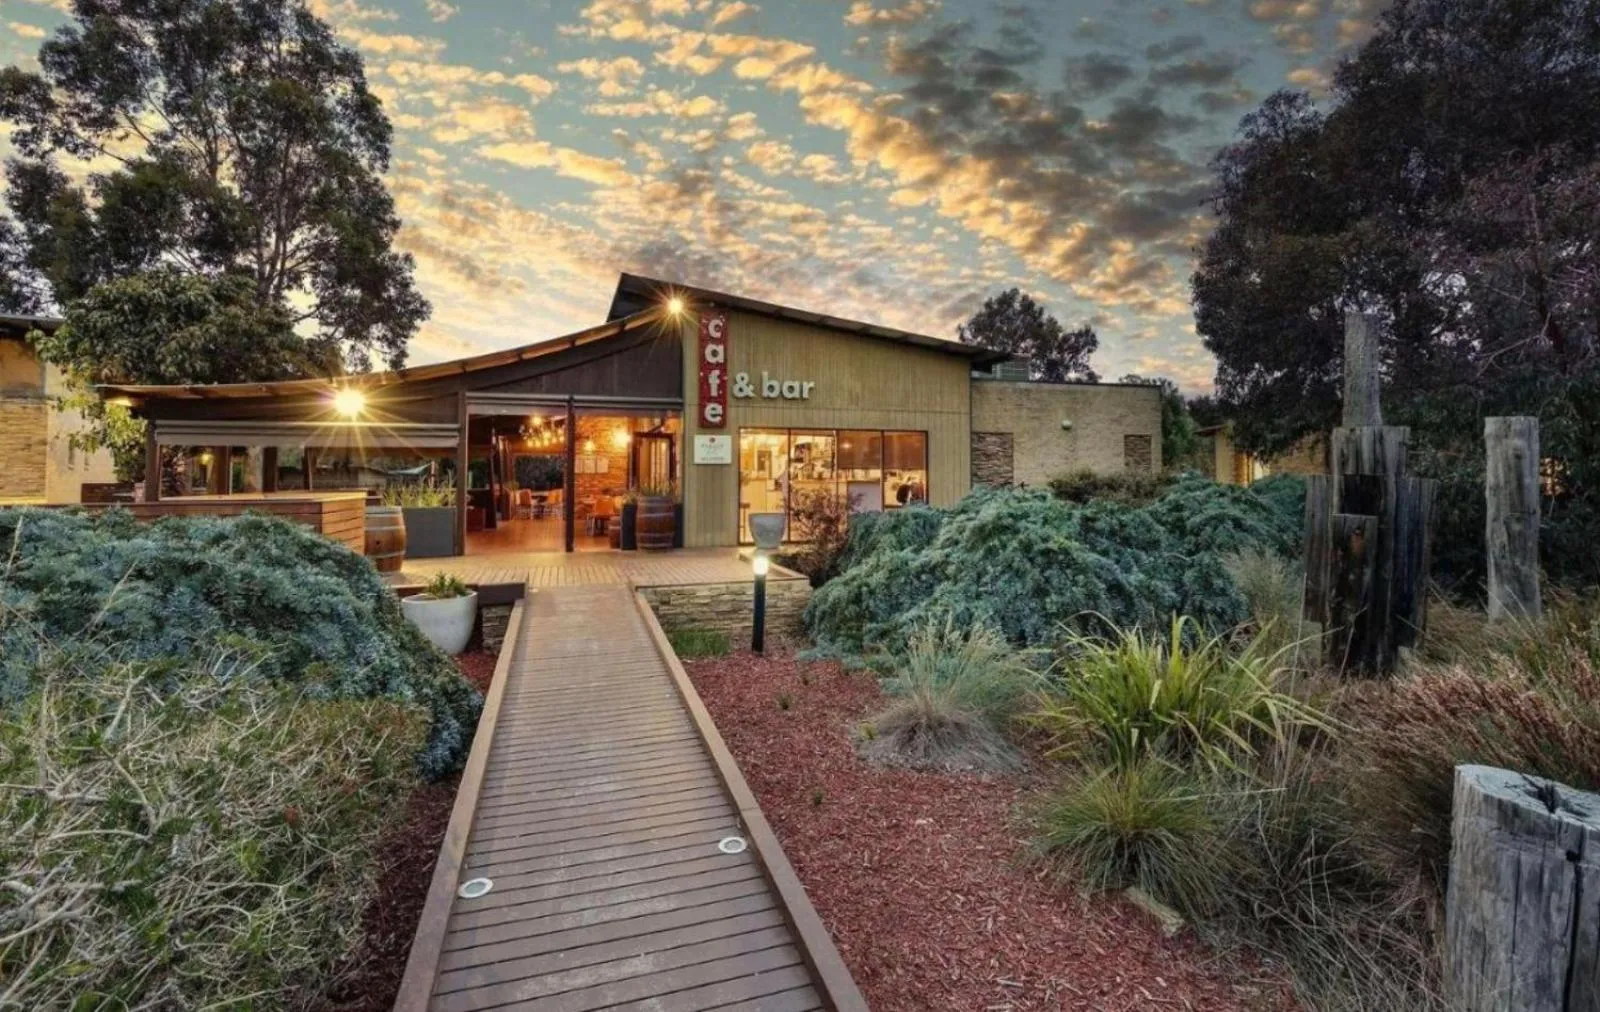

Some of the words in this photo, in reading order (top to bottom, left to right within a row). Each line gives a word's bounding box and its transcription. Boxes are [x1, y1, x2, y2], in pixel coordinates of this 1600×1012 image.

[704, 319, 725, 423] cafe
[732, 372, 755, 398] &
[762, 371, 815, 399] bar
